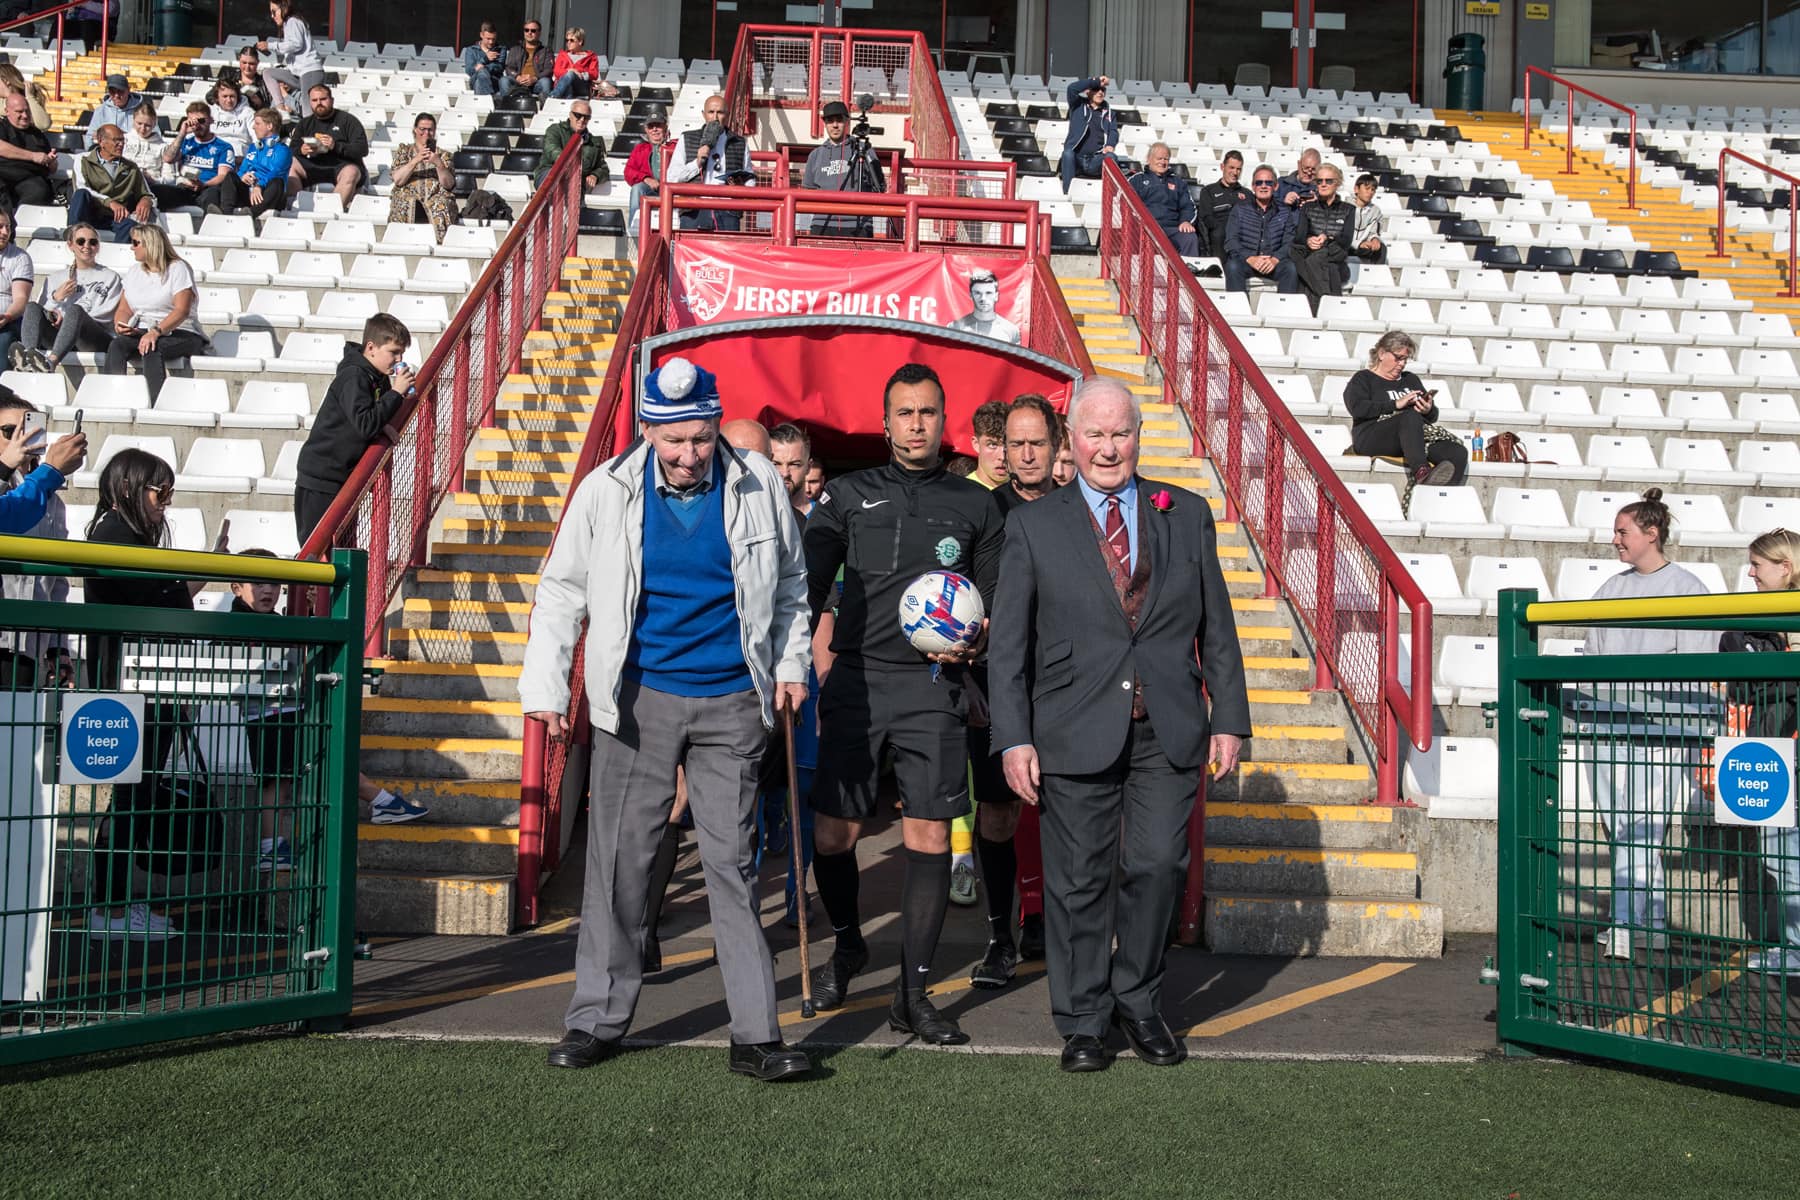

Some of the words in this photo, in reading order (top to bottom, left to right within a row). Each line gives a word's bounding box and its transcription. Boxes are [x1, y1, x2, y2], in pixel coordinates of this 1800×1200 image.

[695, 269, 725, 281] BULLS
[733, 286, 820, 314] JERSEY
[826, 291, 901, 319] BULLS
[908, 295, 937, 322] FC
[77, 716, 103, 729] Fire
[105, 716, 129, 729] exit
[87, 735, 119, 750] keep
[86, 753, 119, 766] clear
[1728, 758, 1752, 772] Fire
[1755, 760, 1779, 773] exit
[1737, 777, 1769, 793] keep
[1737, 794, 1770, 808] clear
